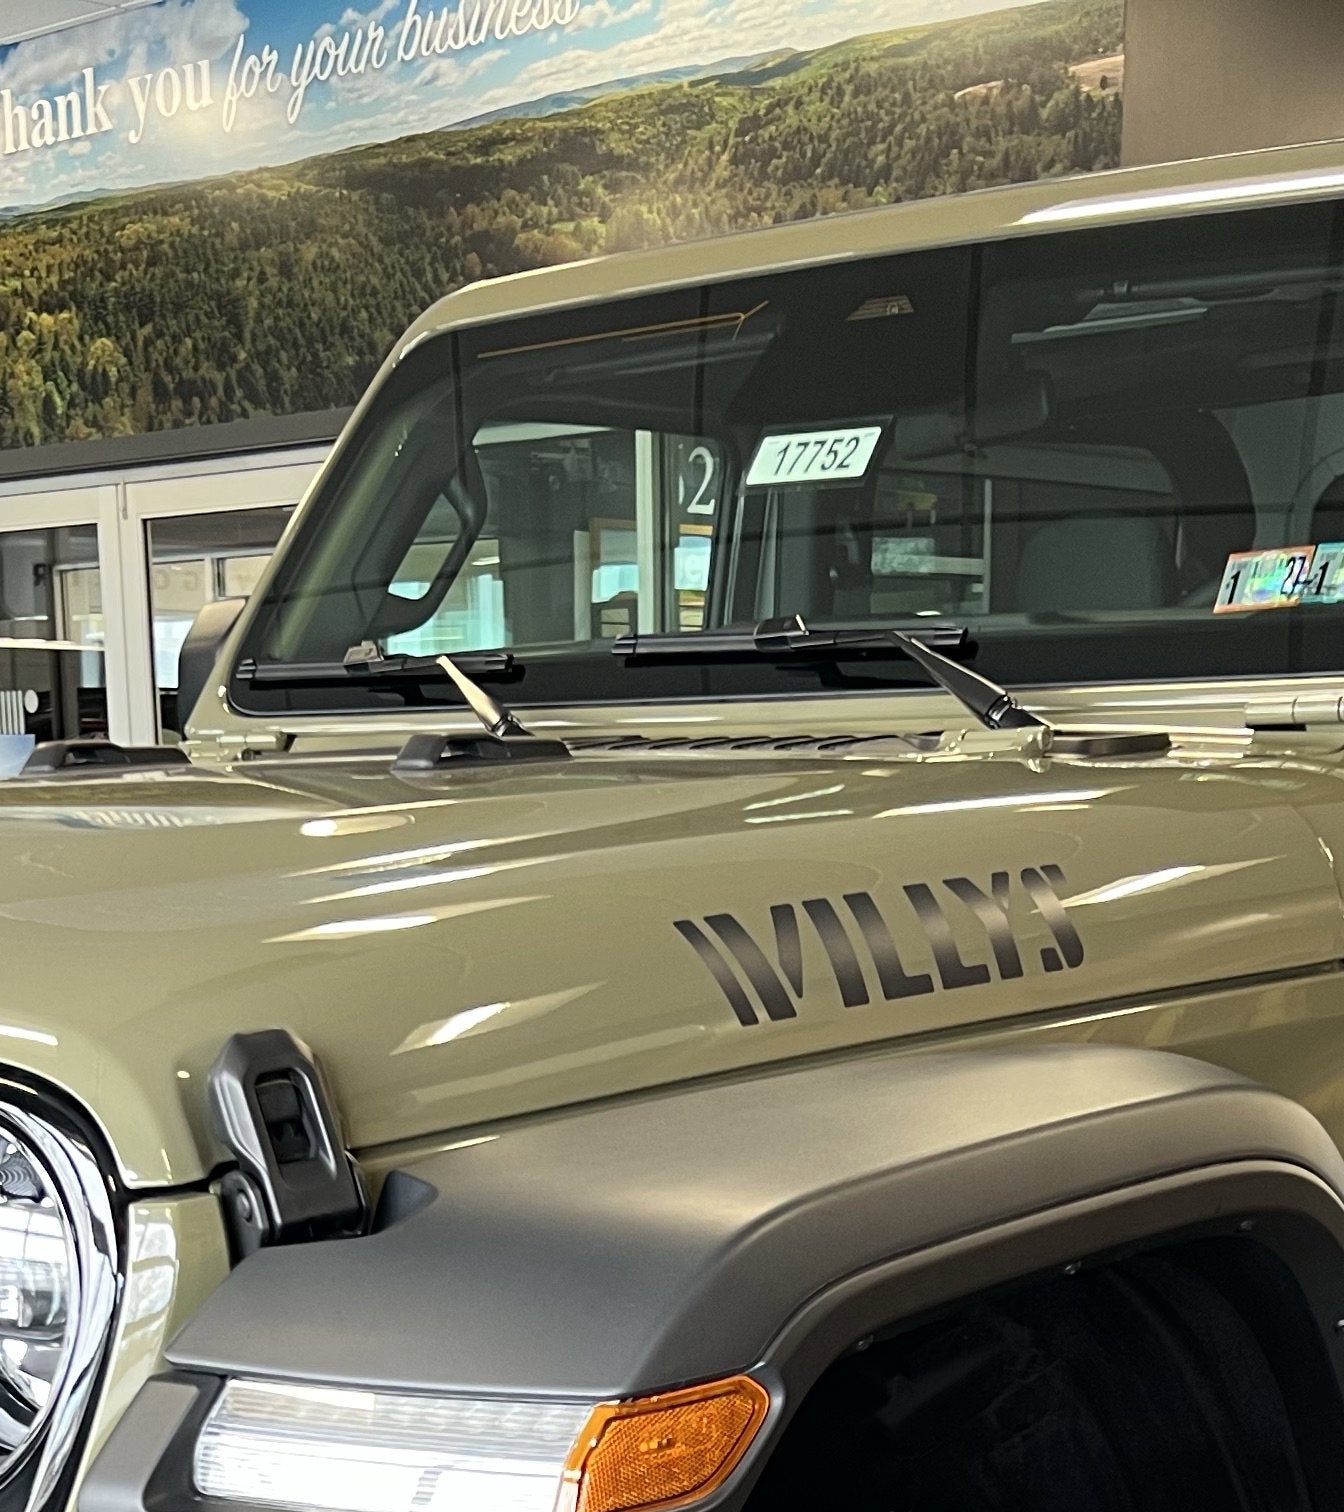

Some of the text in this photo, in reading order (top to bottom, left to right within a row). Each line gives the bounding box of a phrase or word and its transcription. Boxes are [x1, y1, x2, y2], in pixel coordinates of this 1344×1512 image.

[129, 58, 214, 144] you
[222, 34, 282, 132] for
[287, 20, 387, 123] your
[773, 436, 860, 477] 17752
[672, 863, 1084, 1026] WILLYS
